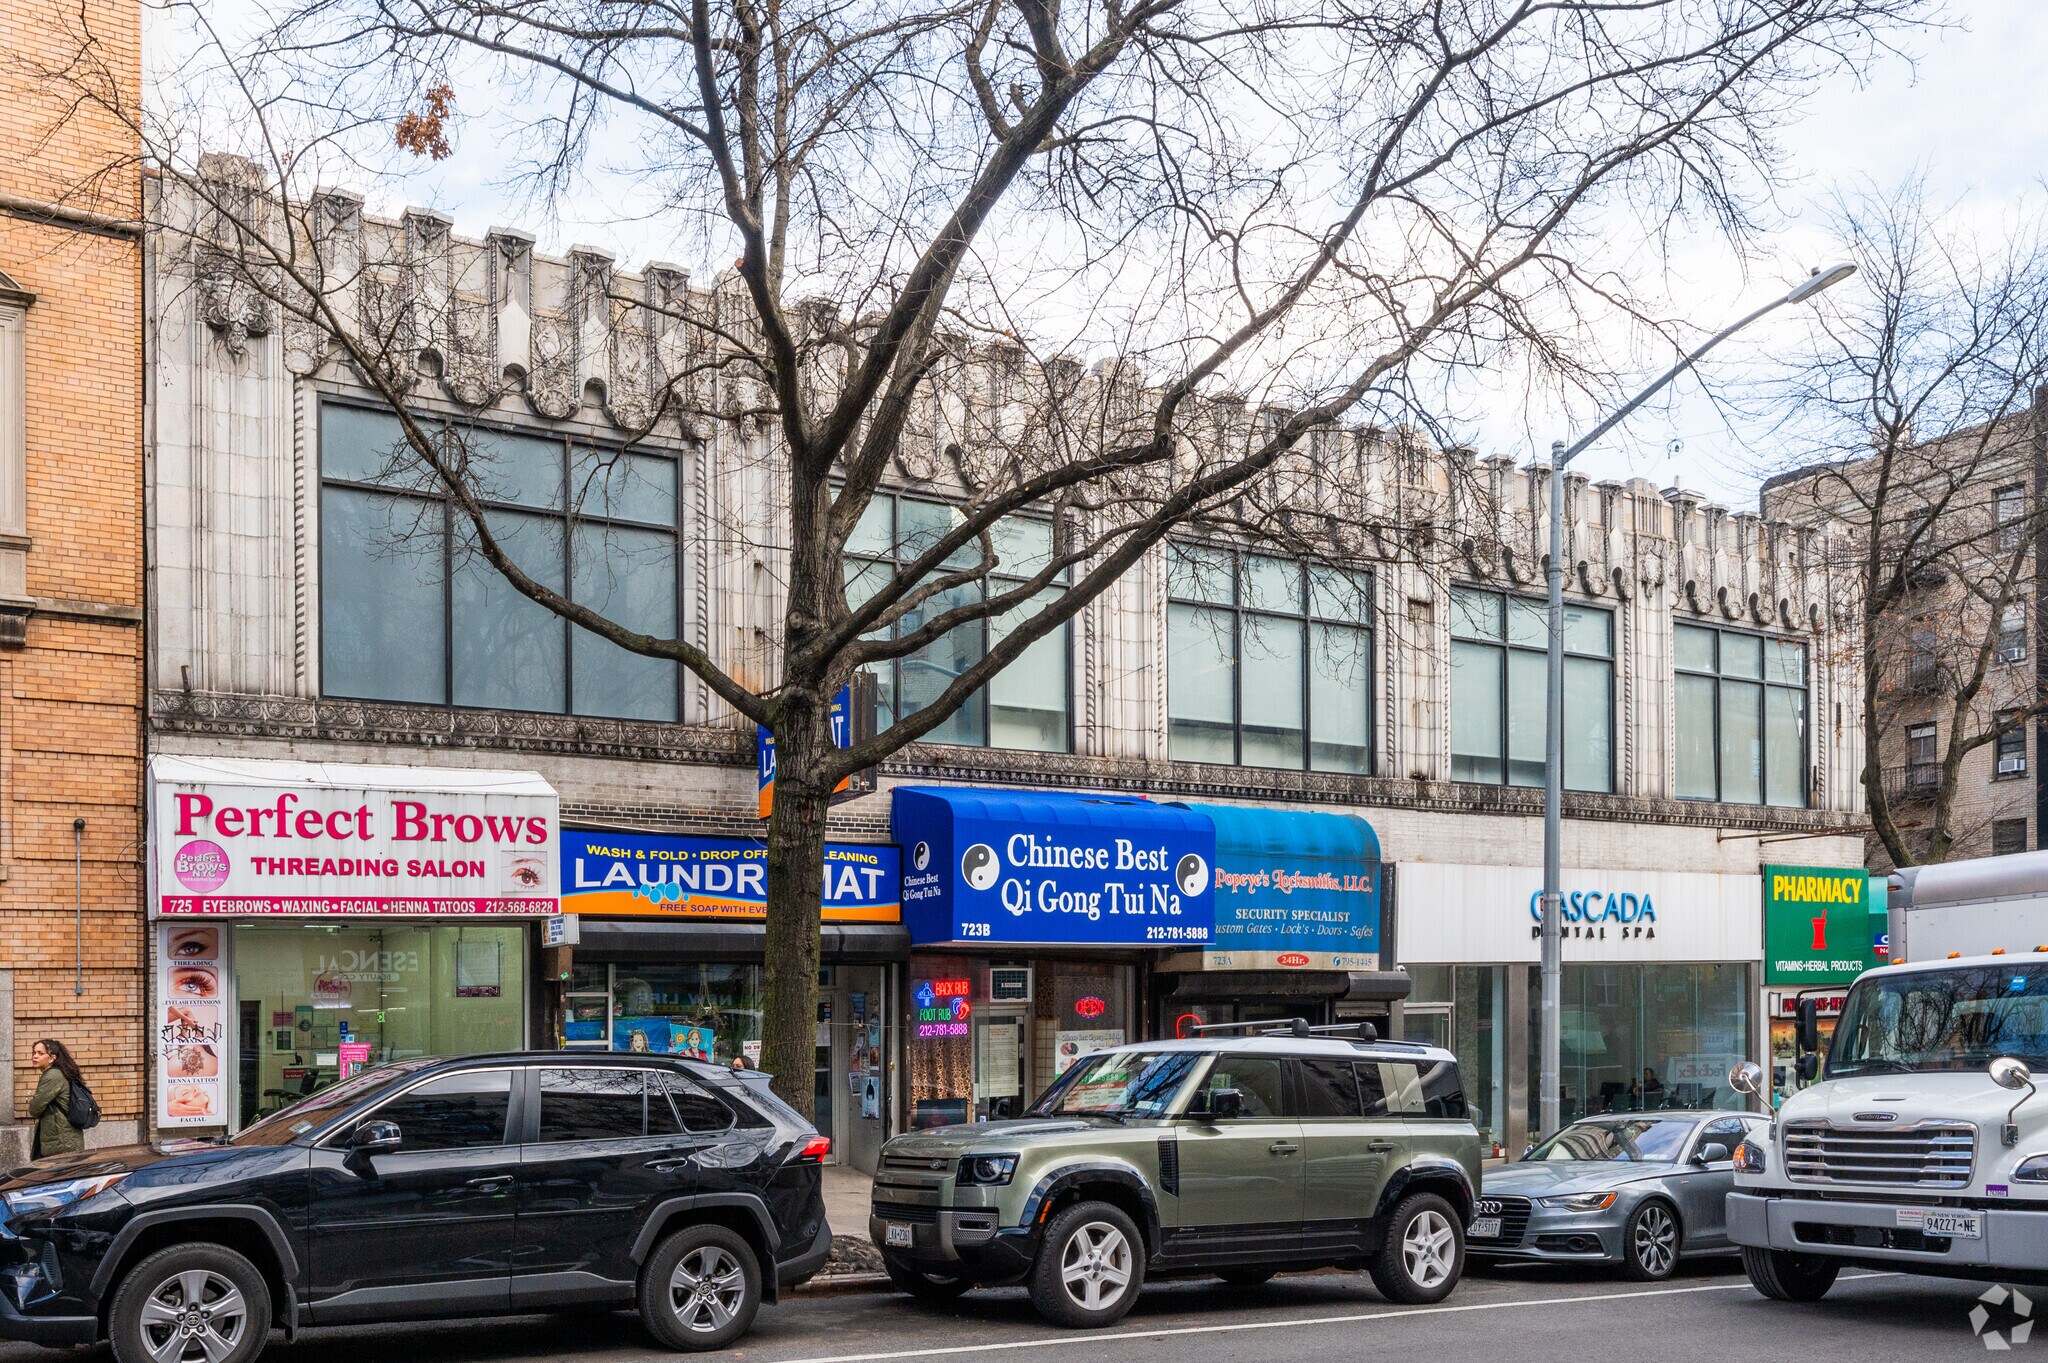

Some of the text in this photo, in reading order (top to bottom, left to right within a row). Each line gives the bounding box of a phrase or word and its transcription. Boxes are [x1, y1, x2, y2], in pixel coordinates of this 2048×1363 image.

[173, 793, 548, 844] Perfect Brows
[180, 853, 221, 862] Perfect
[586, 844, 631, 858] WASH
[635, 850, 646, 860] &
[650, 850, 689, 860] FOLD
[701, 850, 740, 860] DROP
[1007, 833, 1169, 871] Chinese Best
[177, 860, 227, 873] Brows
[192, 869, 216, 878] NYC
[251, 857, 485, 878] THREADING SALON
[904, 873, 939, 887] Chinese Best
[1215, 867, 1270, 894] Popeye's
[903, 886, 941, 901] Qi Gong Tui Na
[1773, 875, 1862, 903] PHARMACY
[170, 899, 553, 913] 725 EYEBROWS WAXING FACIAL HENNA TATOOS 212-568-6828
[1001, 878, 1182, 921] Qi Gong Tui Na
[660, 904, 687, 912] FREE
[690, 904, 719, 913] SOAP
[721, 905, 746, 914] WITH
[1235, 908, 1350, 922] SECURITY SPECIALIST
[961, 923, 1208, 939] 723B 212-781-5888
[1215, 922, 1373, 940] ustom Gates Lock's Doors Safes
[1532, 926, 1656, 940] DNTAL SPA
[1213, 956, 1232, 965] 723A
[1341, 957, 1372, 967] 795-1445
[1775, 960, 1862, 972] VITAMINS HERBAL PRODUCTS
[457, 986, 500, 997] OPEN
[935, 981, 969, 996] BACK RUB
[1074, 998, 1105, 1014] OPEN
[920, 1008, 951, 1021] FOOT RUB
[920, 1023, 968, 1036] 212-781-5888
